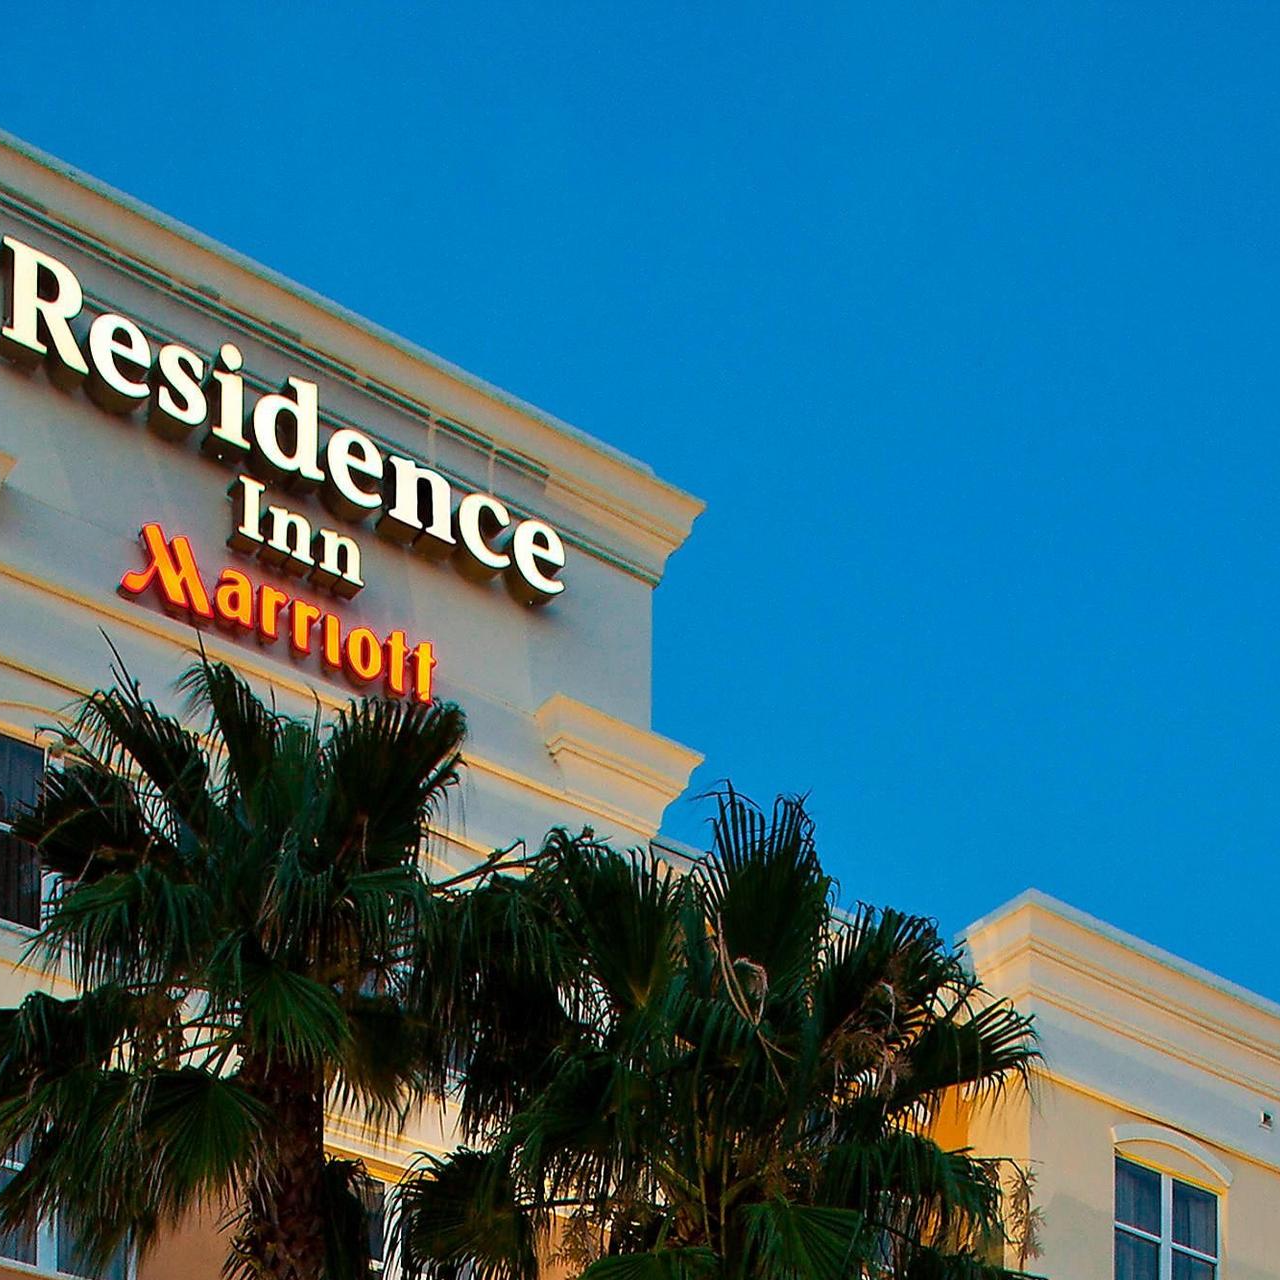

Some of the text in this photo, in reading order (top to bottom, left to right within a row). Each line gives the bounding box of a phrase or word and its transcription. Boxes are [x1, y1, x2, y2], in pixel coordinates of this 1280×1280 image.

[1, 235, 566, 594] Residence
[119, 522, 437, 706] Marriott
[236, 474, 366, 589] Inn
